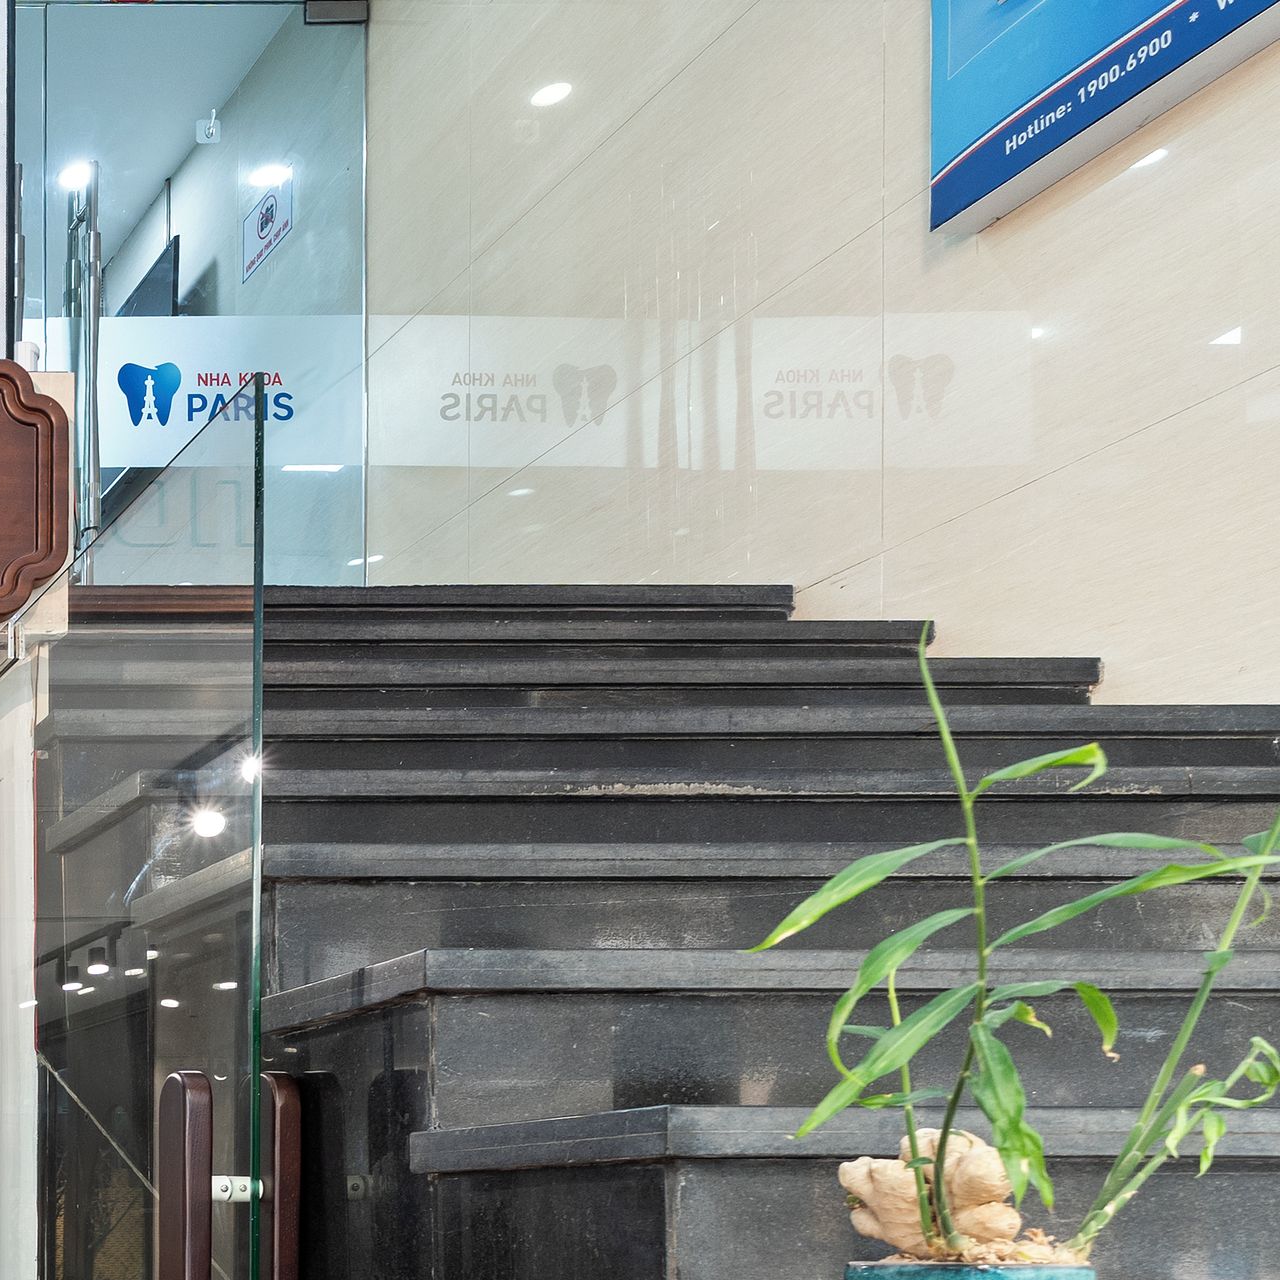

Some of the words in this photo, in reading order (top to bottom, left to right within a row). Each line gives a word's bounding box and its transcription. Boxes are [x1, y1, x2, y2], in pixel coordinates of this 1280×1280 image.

[1005, 102, 1073, 155] Hotline:
[1077, 29, 1173, 104] 1900.6900
[197, 373, 231, 386] NHA
[187, 392, 294, 422] PARIS
